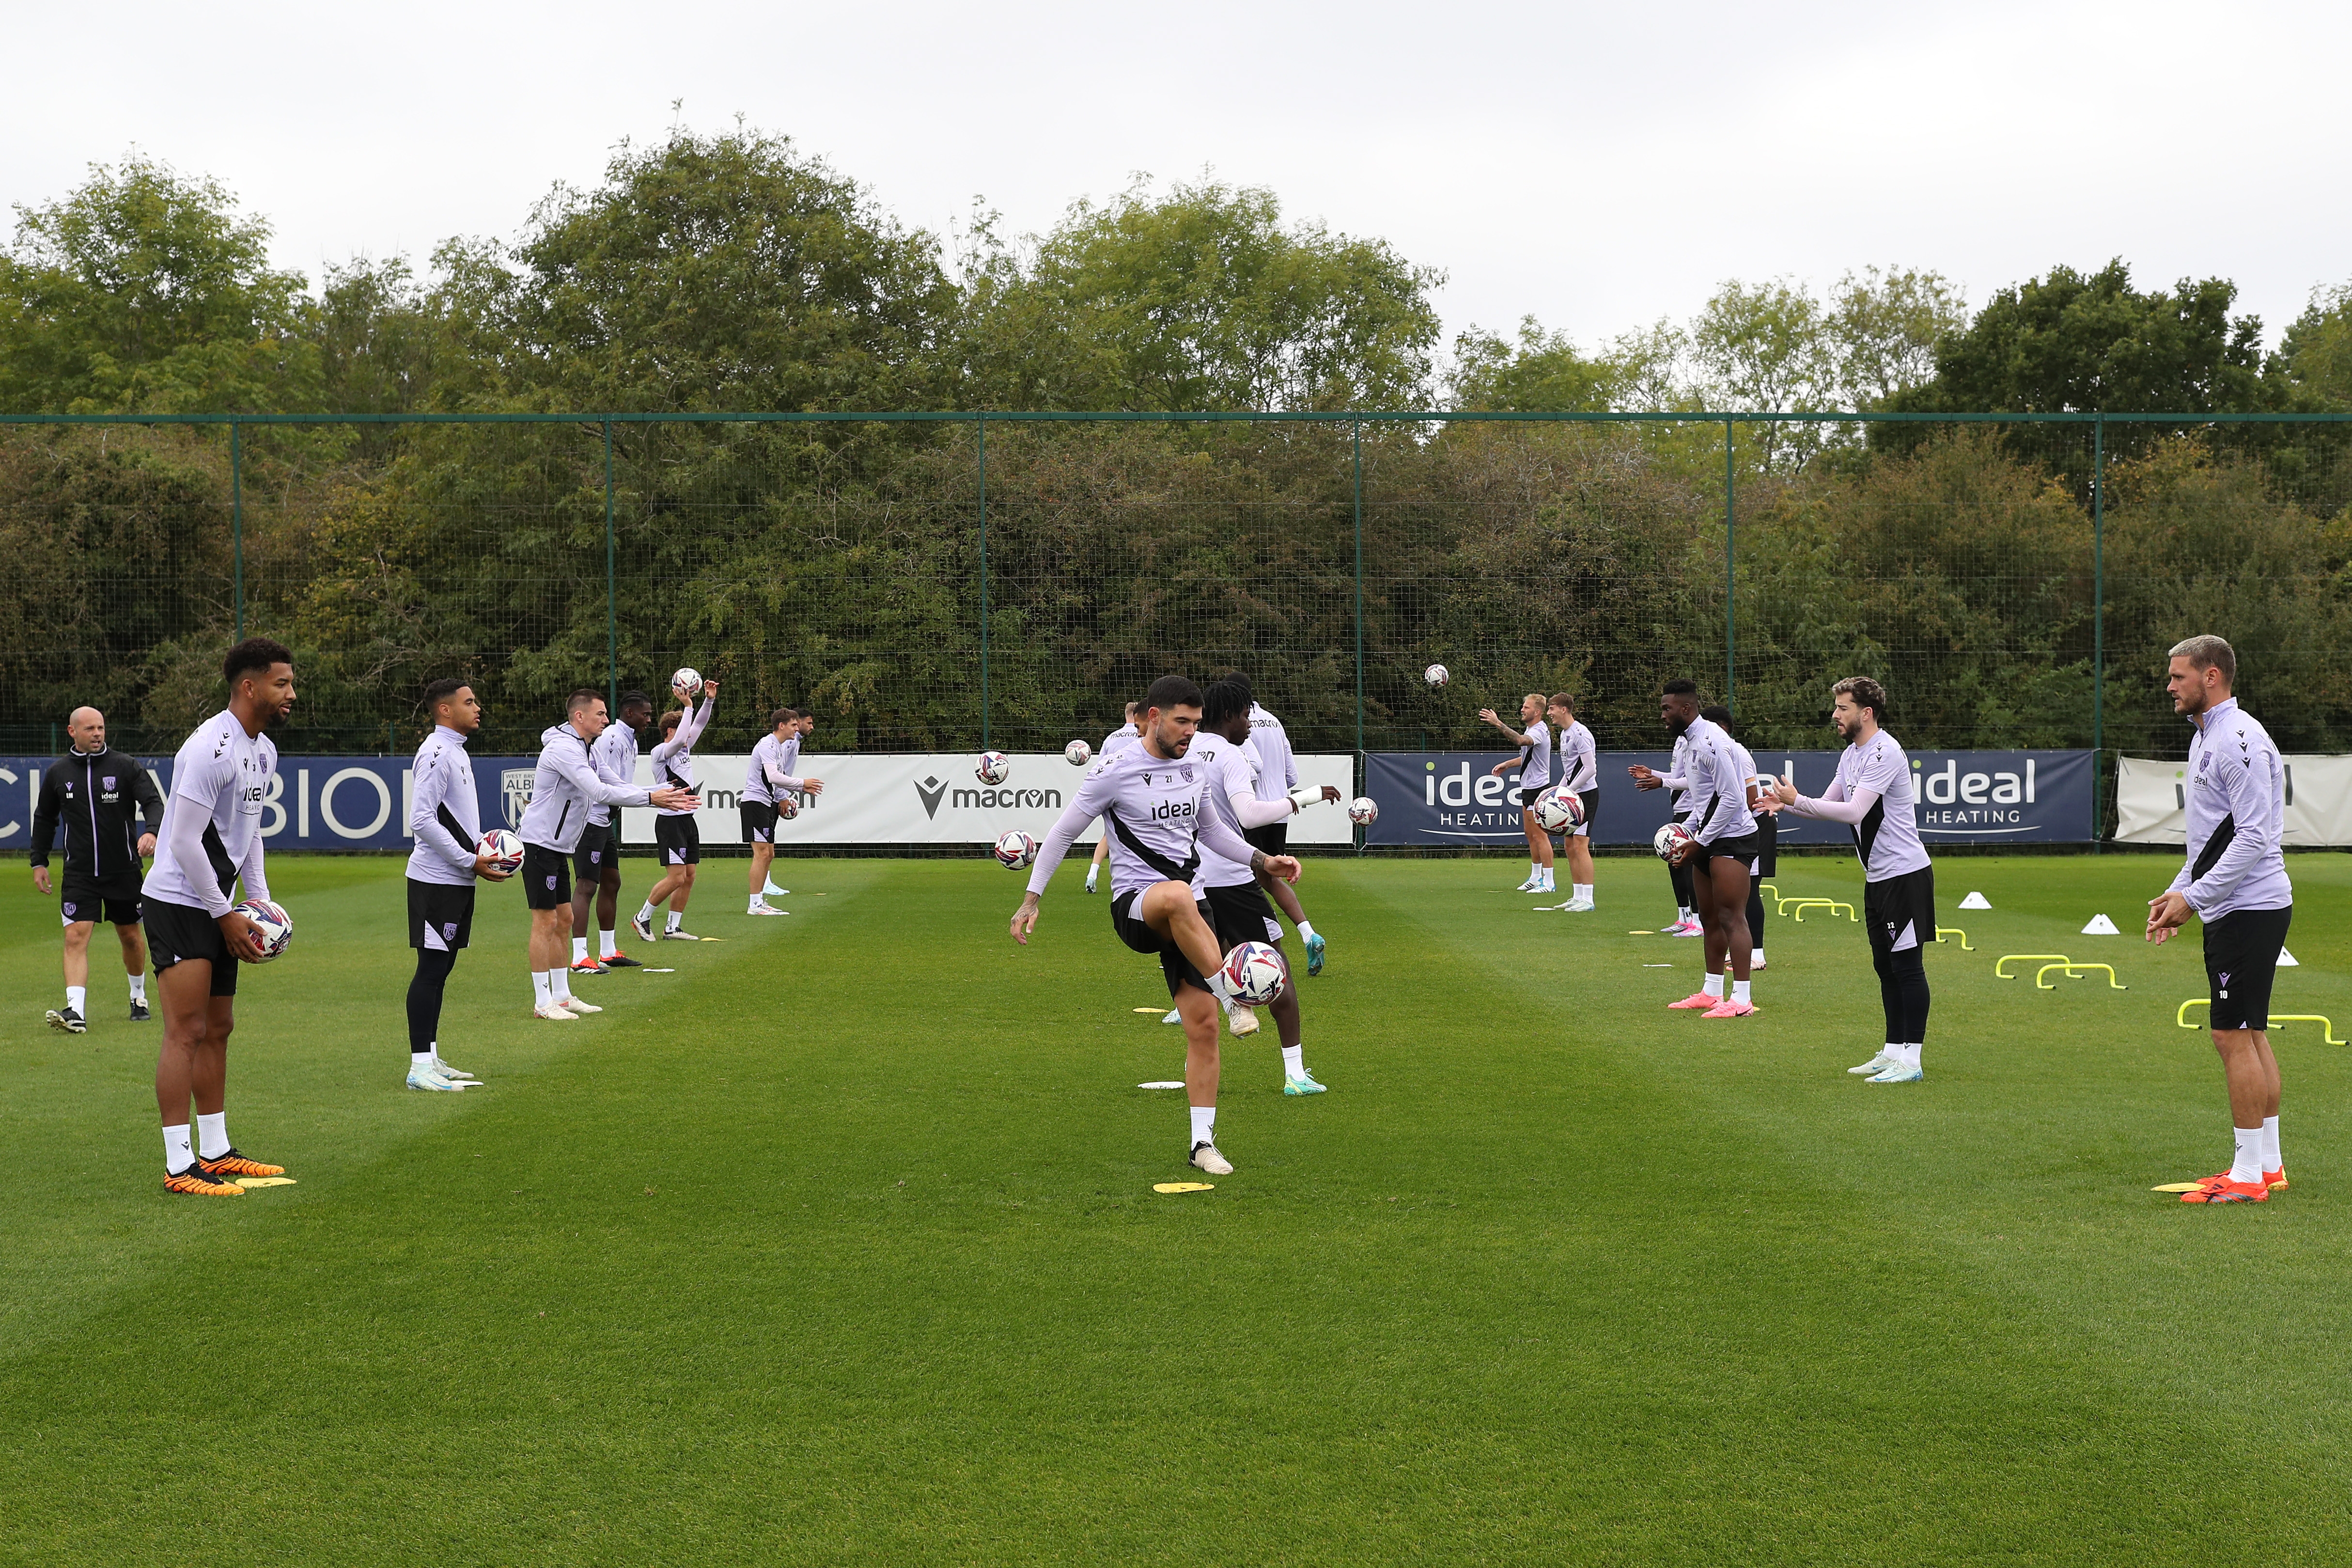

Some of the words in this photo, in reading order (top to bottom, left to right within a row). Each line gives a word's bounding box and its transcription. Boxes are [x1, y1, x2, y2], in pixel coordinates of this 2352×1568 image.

[1913, 759, 2035, 804] ideal
[952, 789, 1061, 808] macron
[1151, 796, 1195, 821] ideal
[1926, 810, 2020, 823] HEATING
[1158, 818, 1190, 827] HEATING
[2219, 990, 2227, 999] 10
